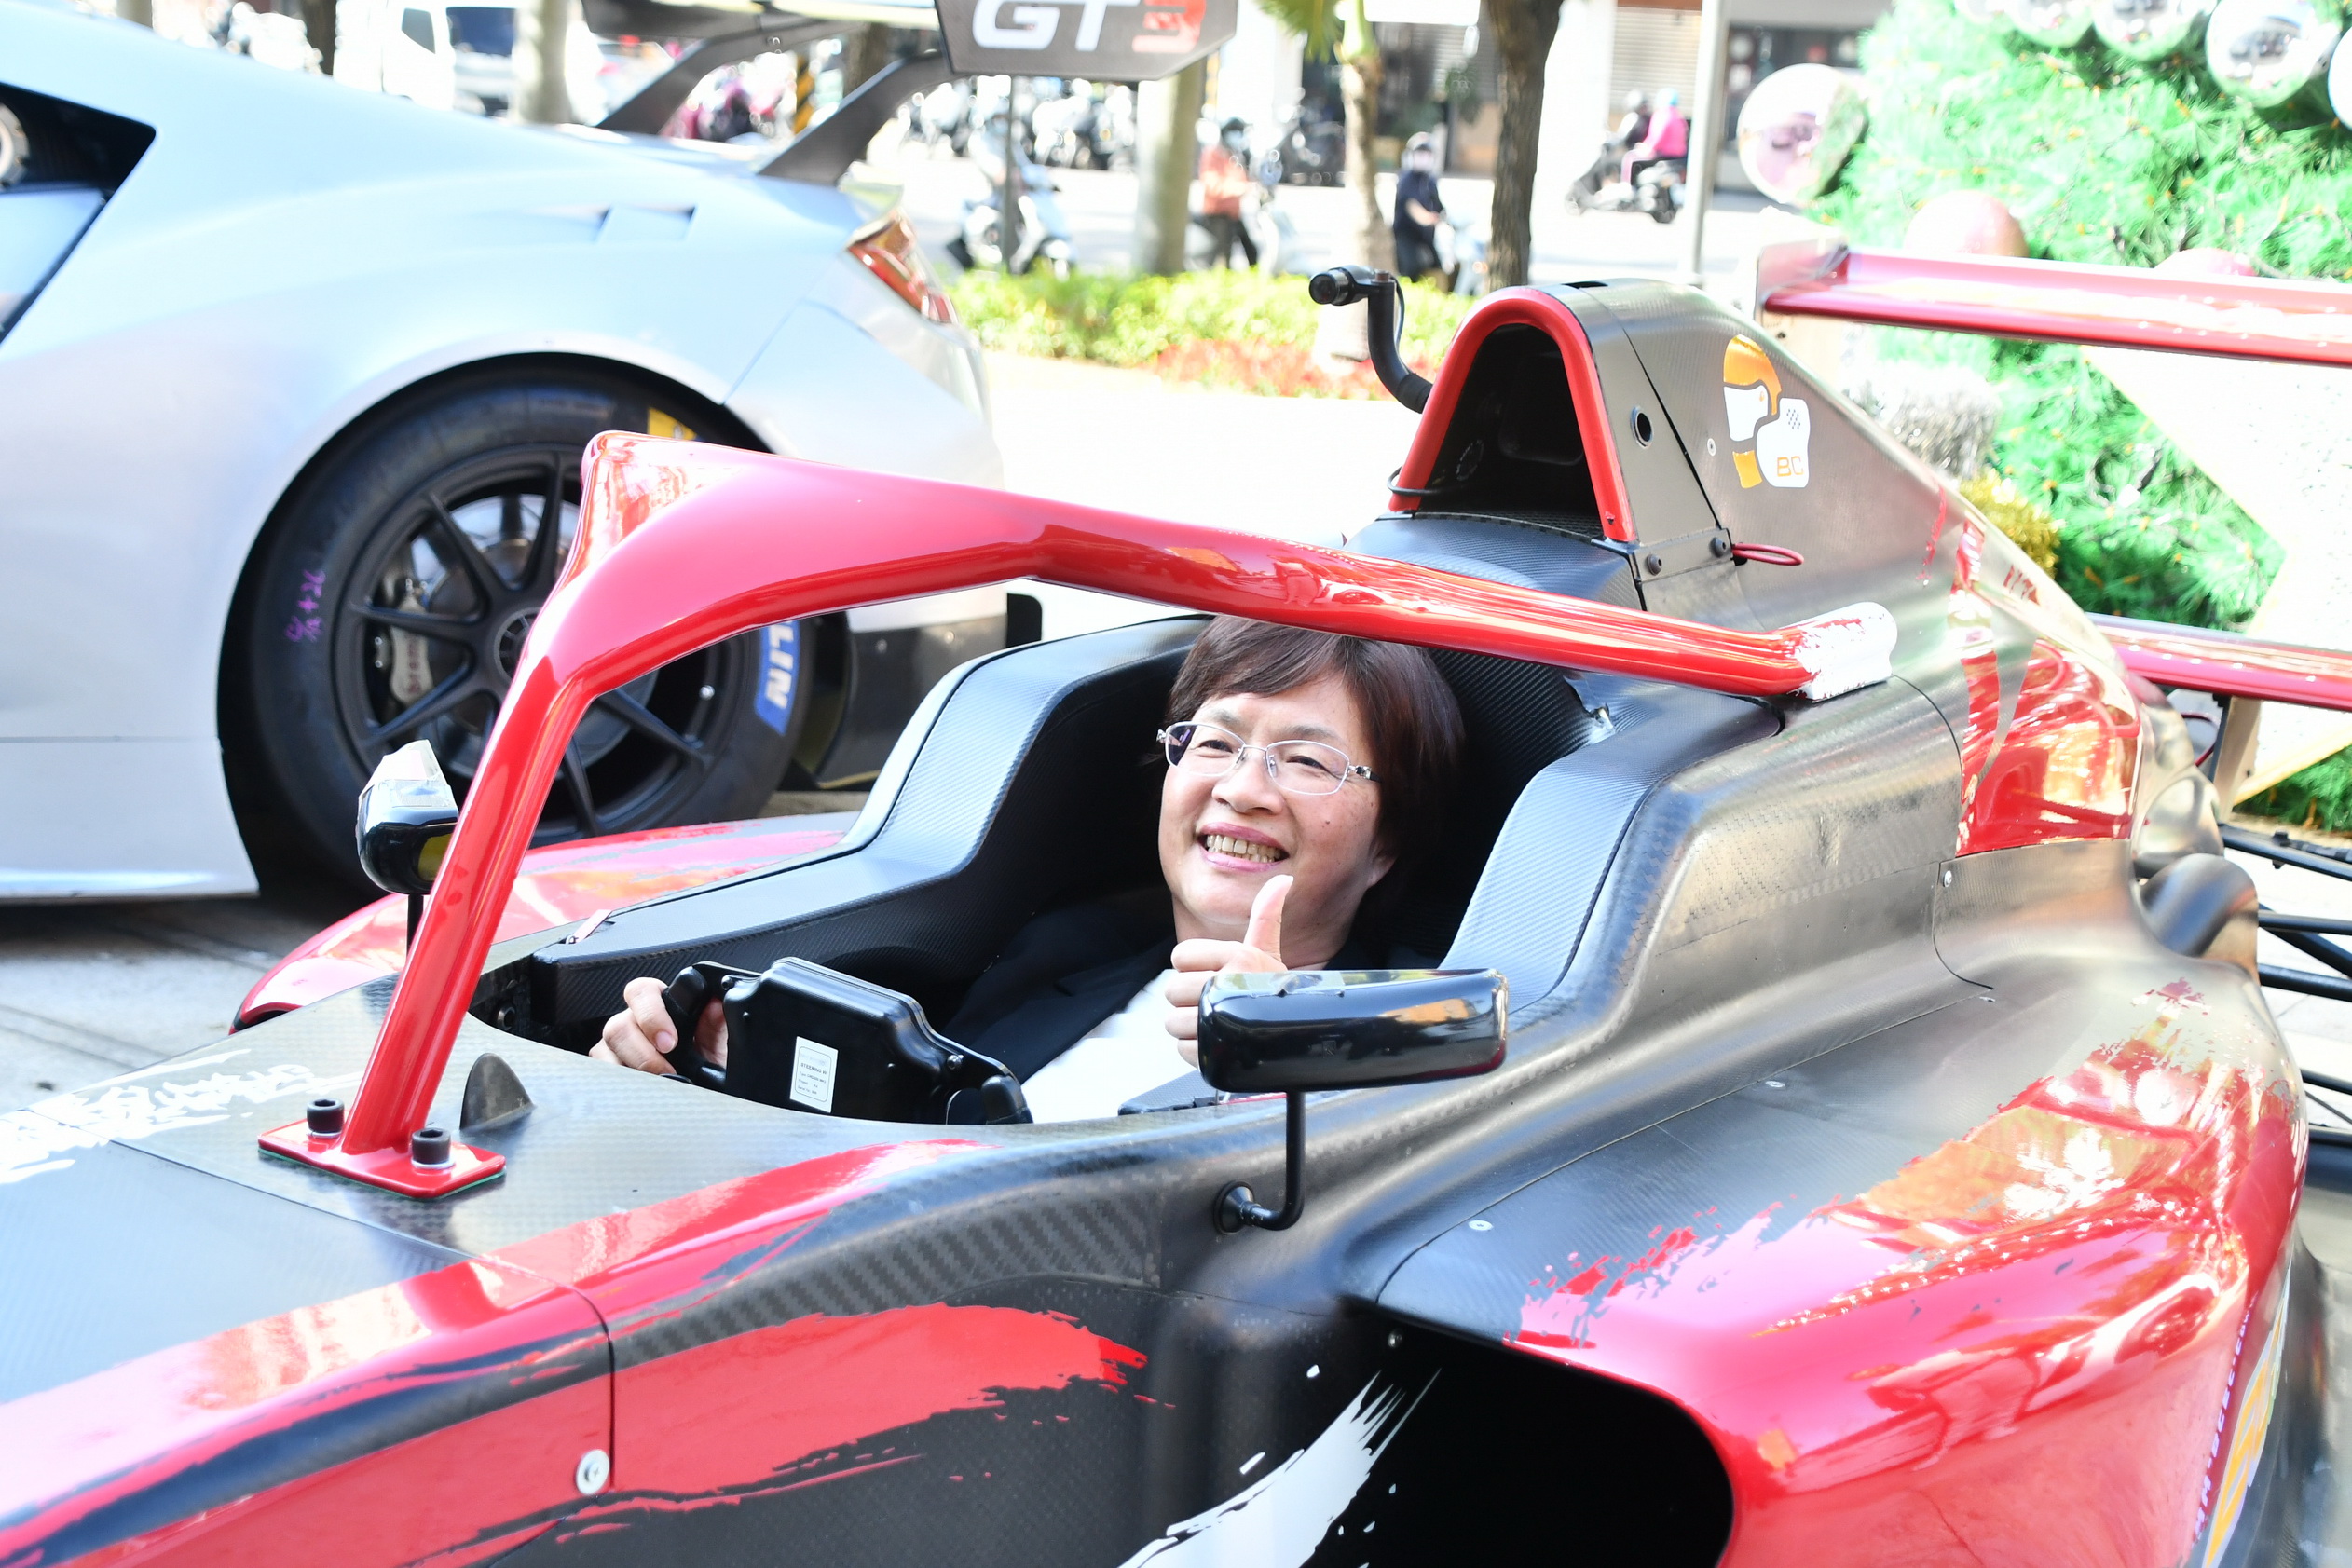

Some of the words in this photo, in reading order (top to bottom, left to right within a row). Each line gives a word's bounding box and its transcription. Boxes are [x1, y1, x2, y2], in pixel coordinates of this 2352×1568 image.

[972, 0, 1207, 53] GT3
[1776, 456, 1805, 478] BC
[766, 619, 794, 709] LIN
